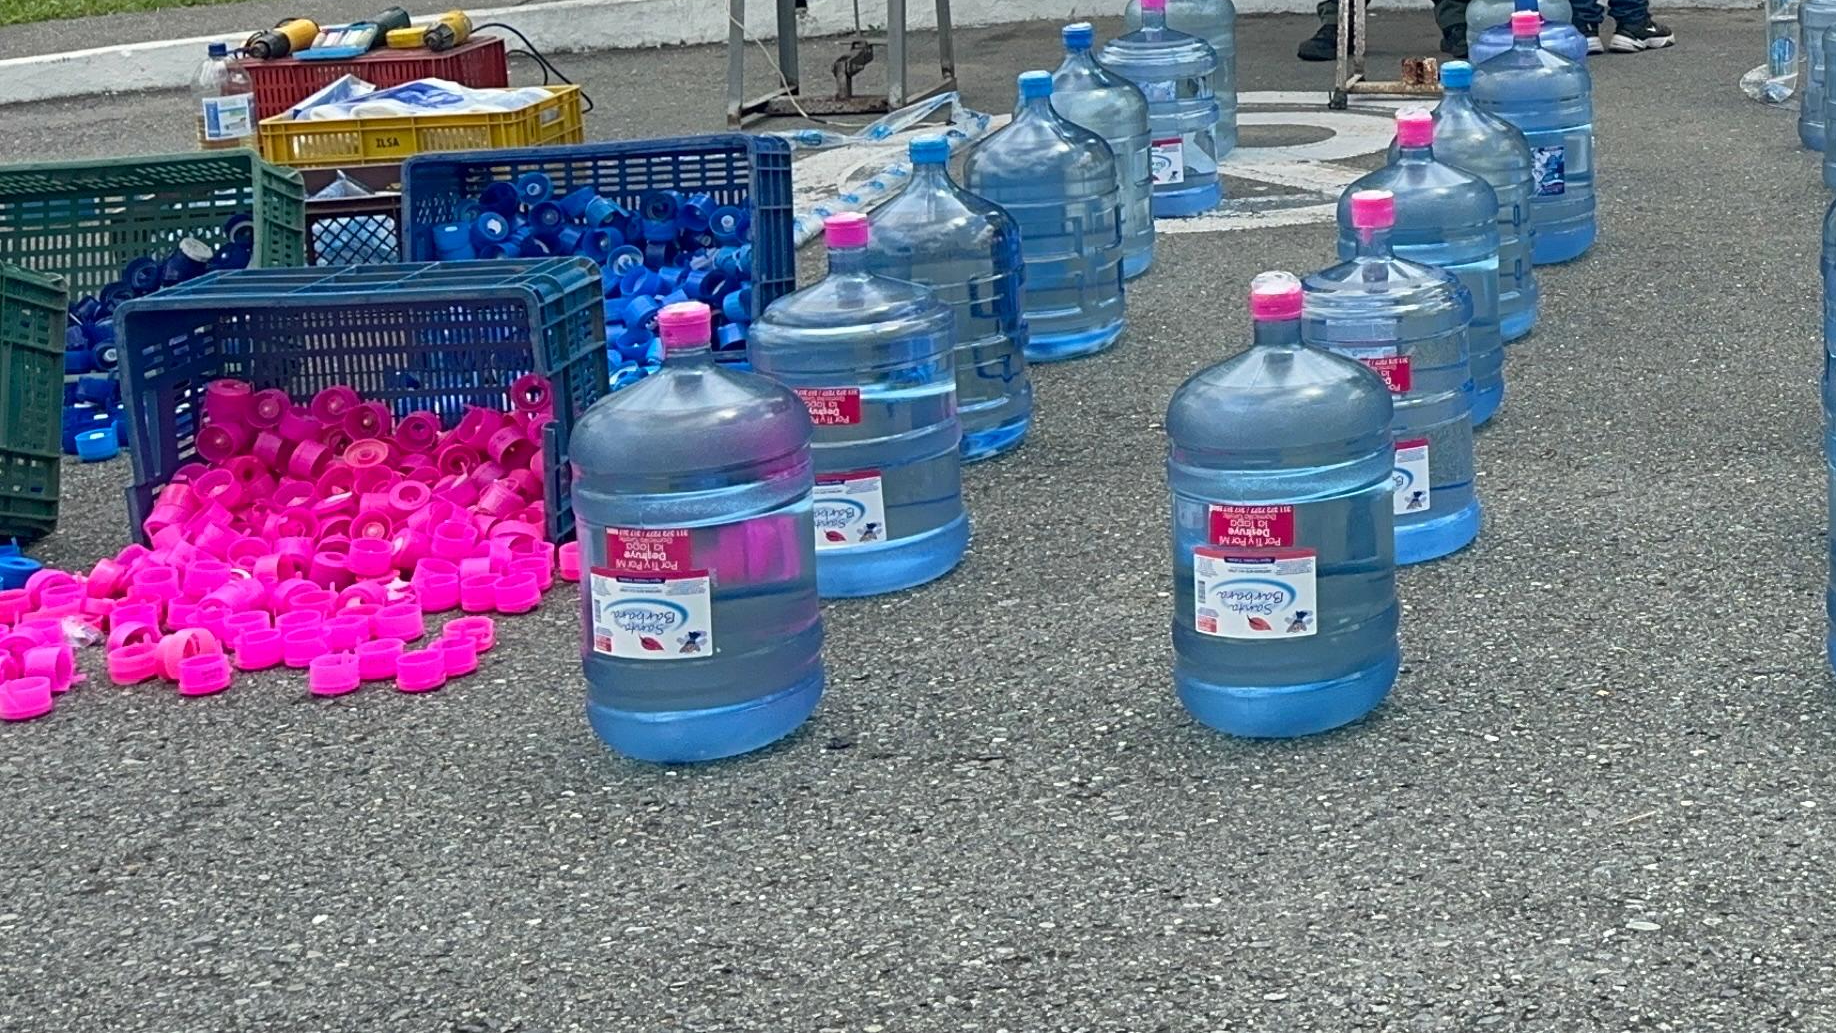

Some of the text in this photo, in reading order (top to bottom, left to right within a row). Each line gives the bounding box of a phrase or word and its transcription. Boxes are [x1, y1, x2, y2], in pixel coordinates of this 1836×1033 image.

[376, 137, 400, 148] ILSA
[808, 407, 840, 416] Destruy
[815, 518, 846, 528] Sant
[1227, 528, 1270, 536] Destruye
[1231, 537, 1246, 545] Por
[1264, 536, 1281, 545] Por
[623, 551, 666, 561] Destruye
[627, 561, 643, 570] Por
[661, 560, 678, 570] Por
[1216, 591, 1283, 603] Barbara
[1230, 603, 1272, 615] Santa
[611, 610, 675, 624] Barbara
[622, 623, 664, 635] Santa
